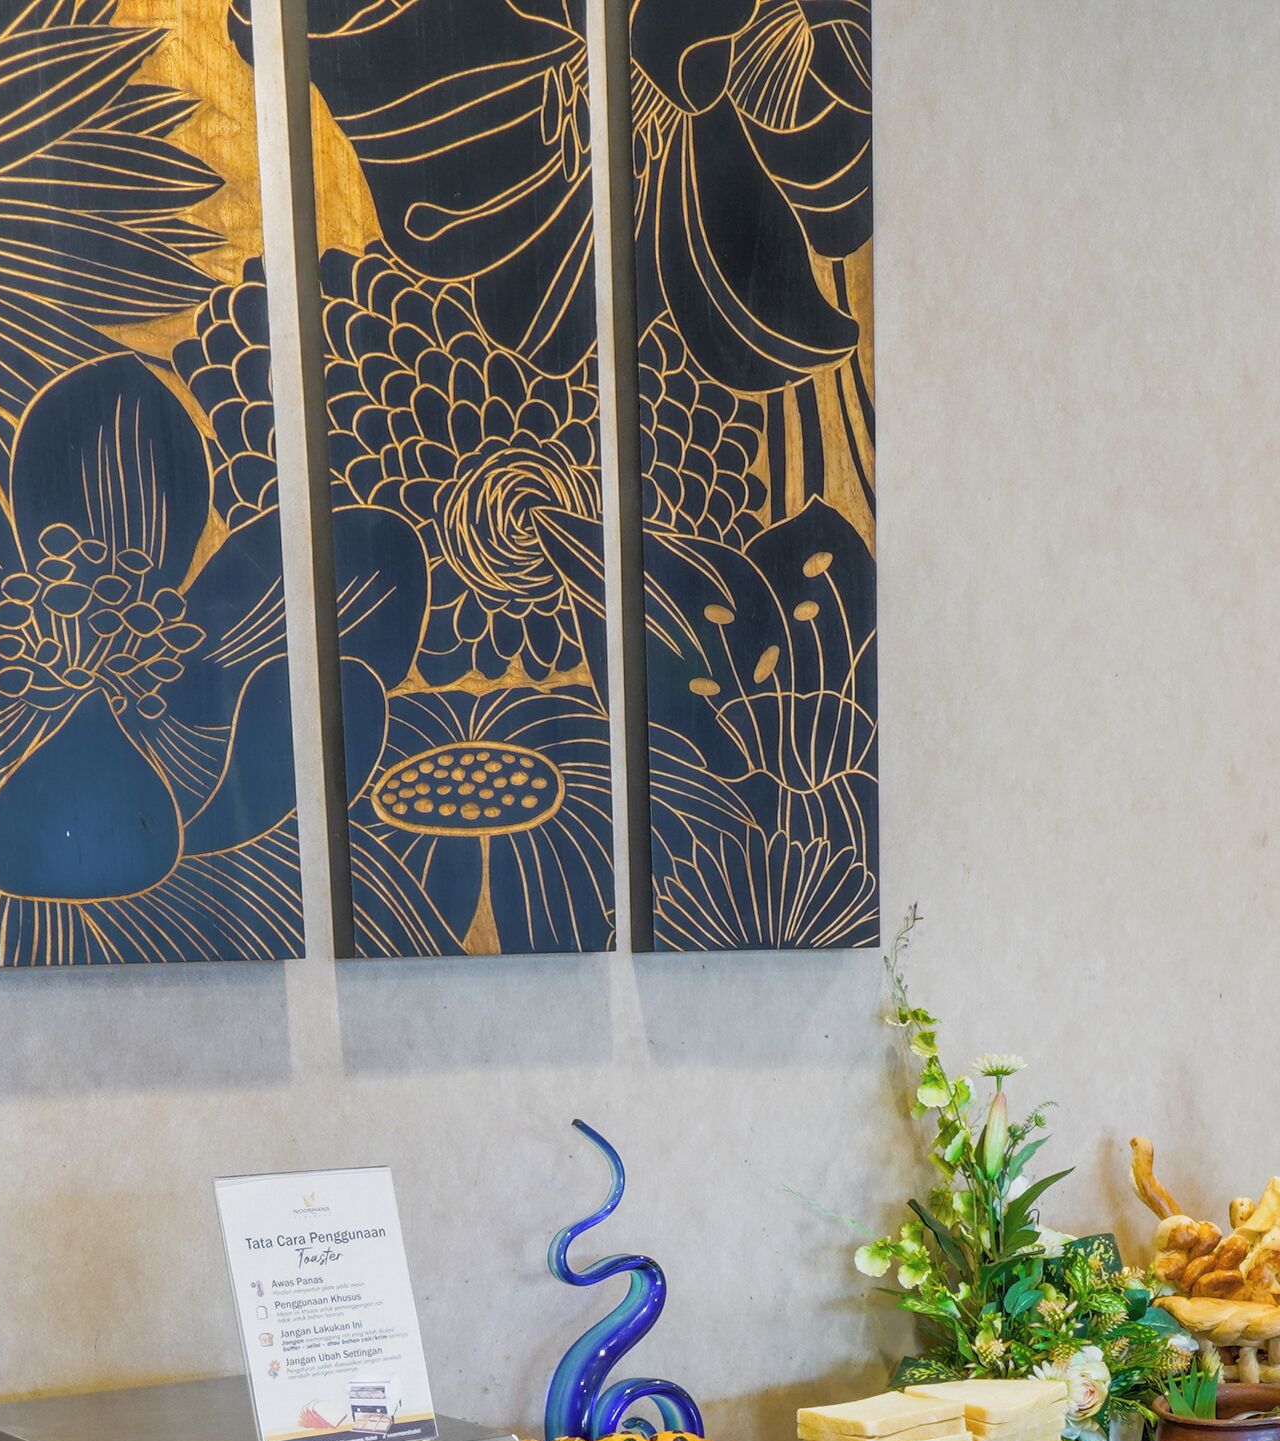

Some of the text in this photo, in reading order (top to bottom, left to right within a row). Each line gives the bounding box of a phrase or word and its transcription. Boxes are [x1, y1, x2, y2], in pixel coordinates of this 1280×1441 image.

[245, 1227, 387, 1250] Tata Cara Penggunaan
[294, 1246, 343, 1269] Toaster
[271, 1276, 324, 1289] Awas Panas
[274, 1293, 362, 1309] Penggunaan Khusus
[280, 1328, 312, 1339] Jangan
[313, 1323, 351, 1334] Lakukan
[352, 1320, 363, 1329] Ini
[285, 1347, 383, 1367] Jangan Ubah Settingan
